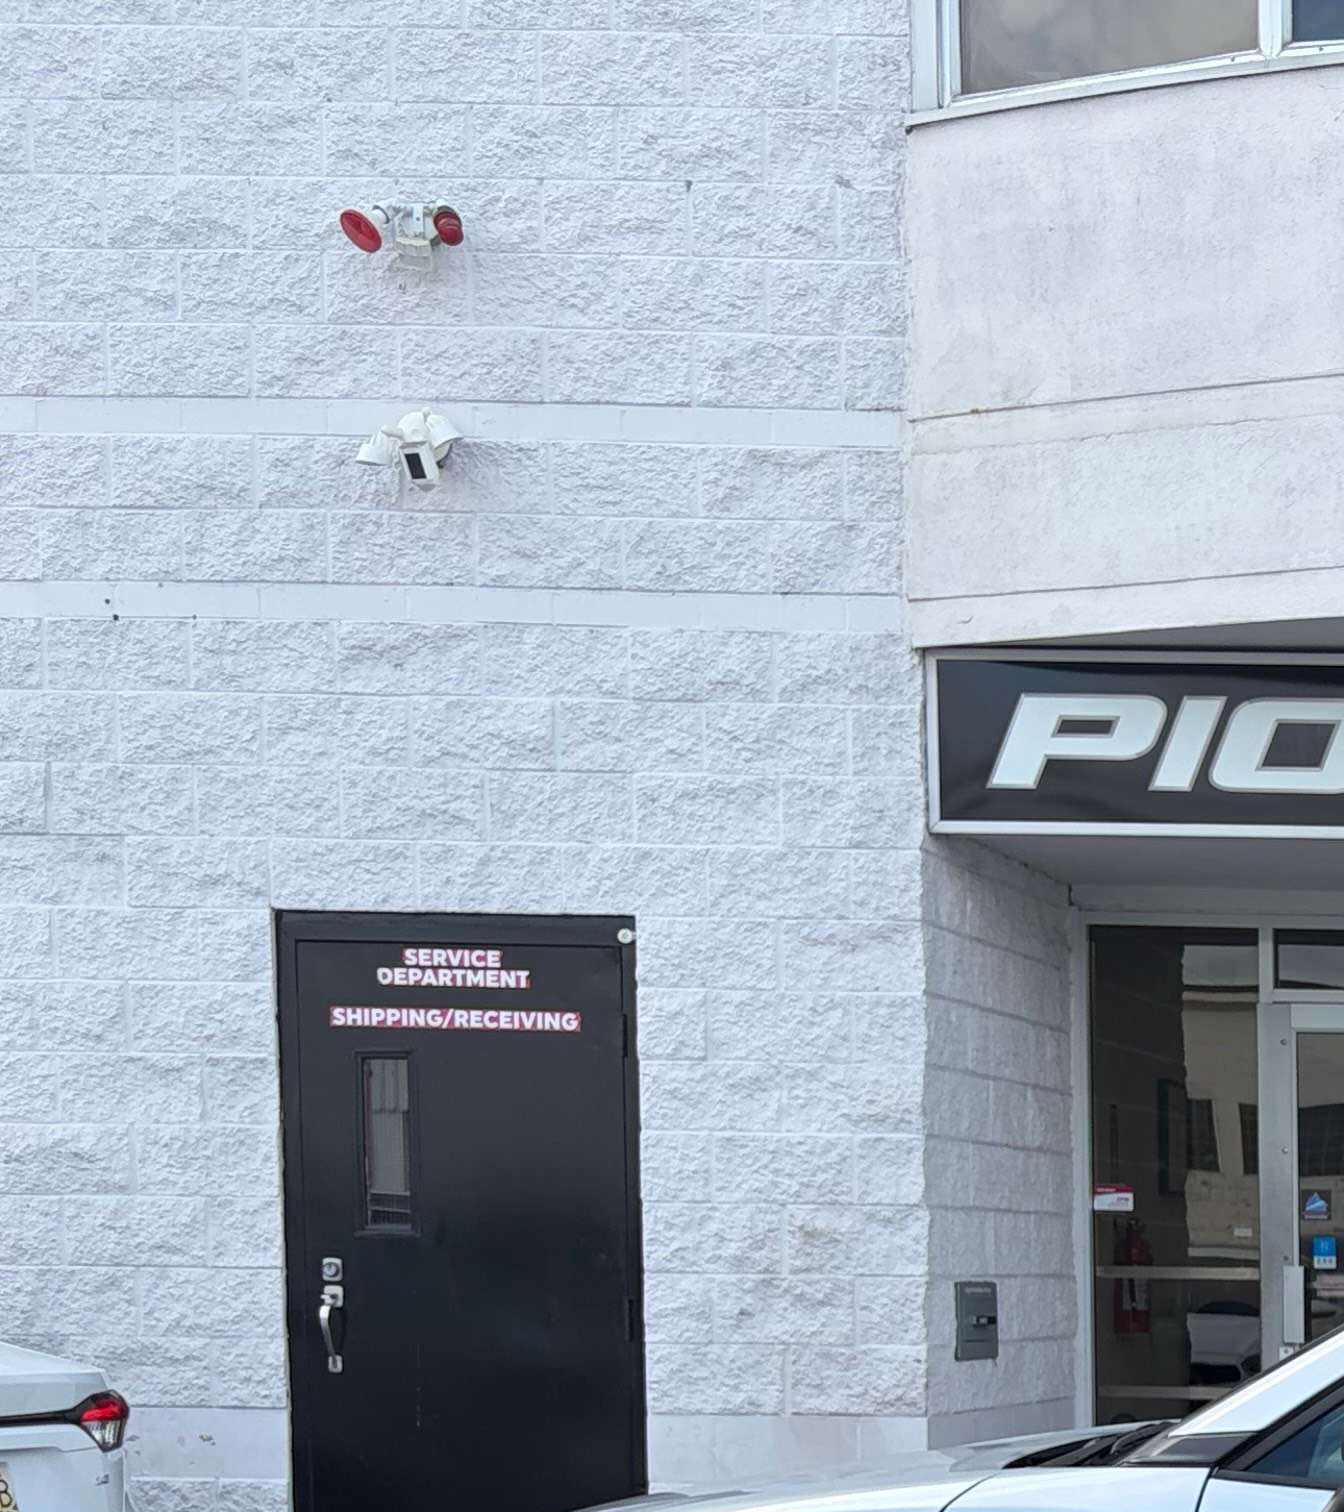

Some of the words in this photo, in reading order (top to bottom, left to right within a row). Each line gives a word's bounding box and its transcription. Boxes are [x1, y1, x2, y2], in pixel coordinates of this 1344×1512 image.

[403, 948, 502, 968] SERVICE
[376, 968, 530, 989] DEPARTMENT
[331, 1007, 580, 1032] SHIPPING/RECEIVING
